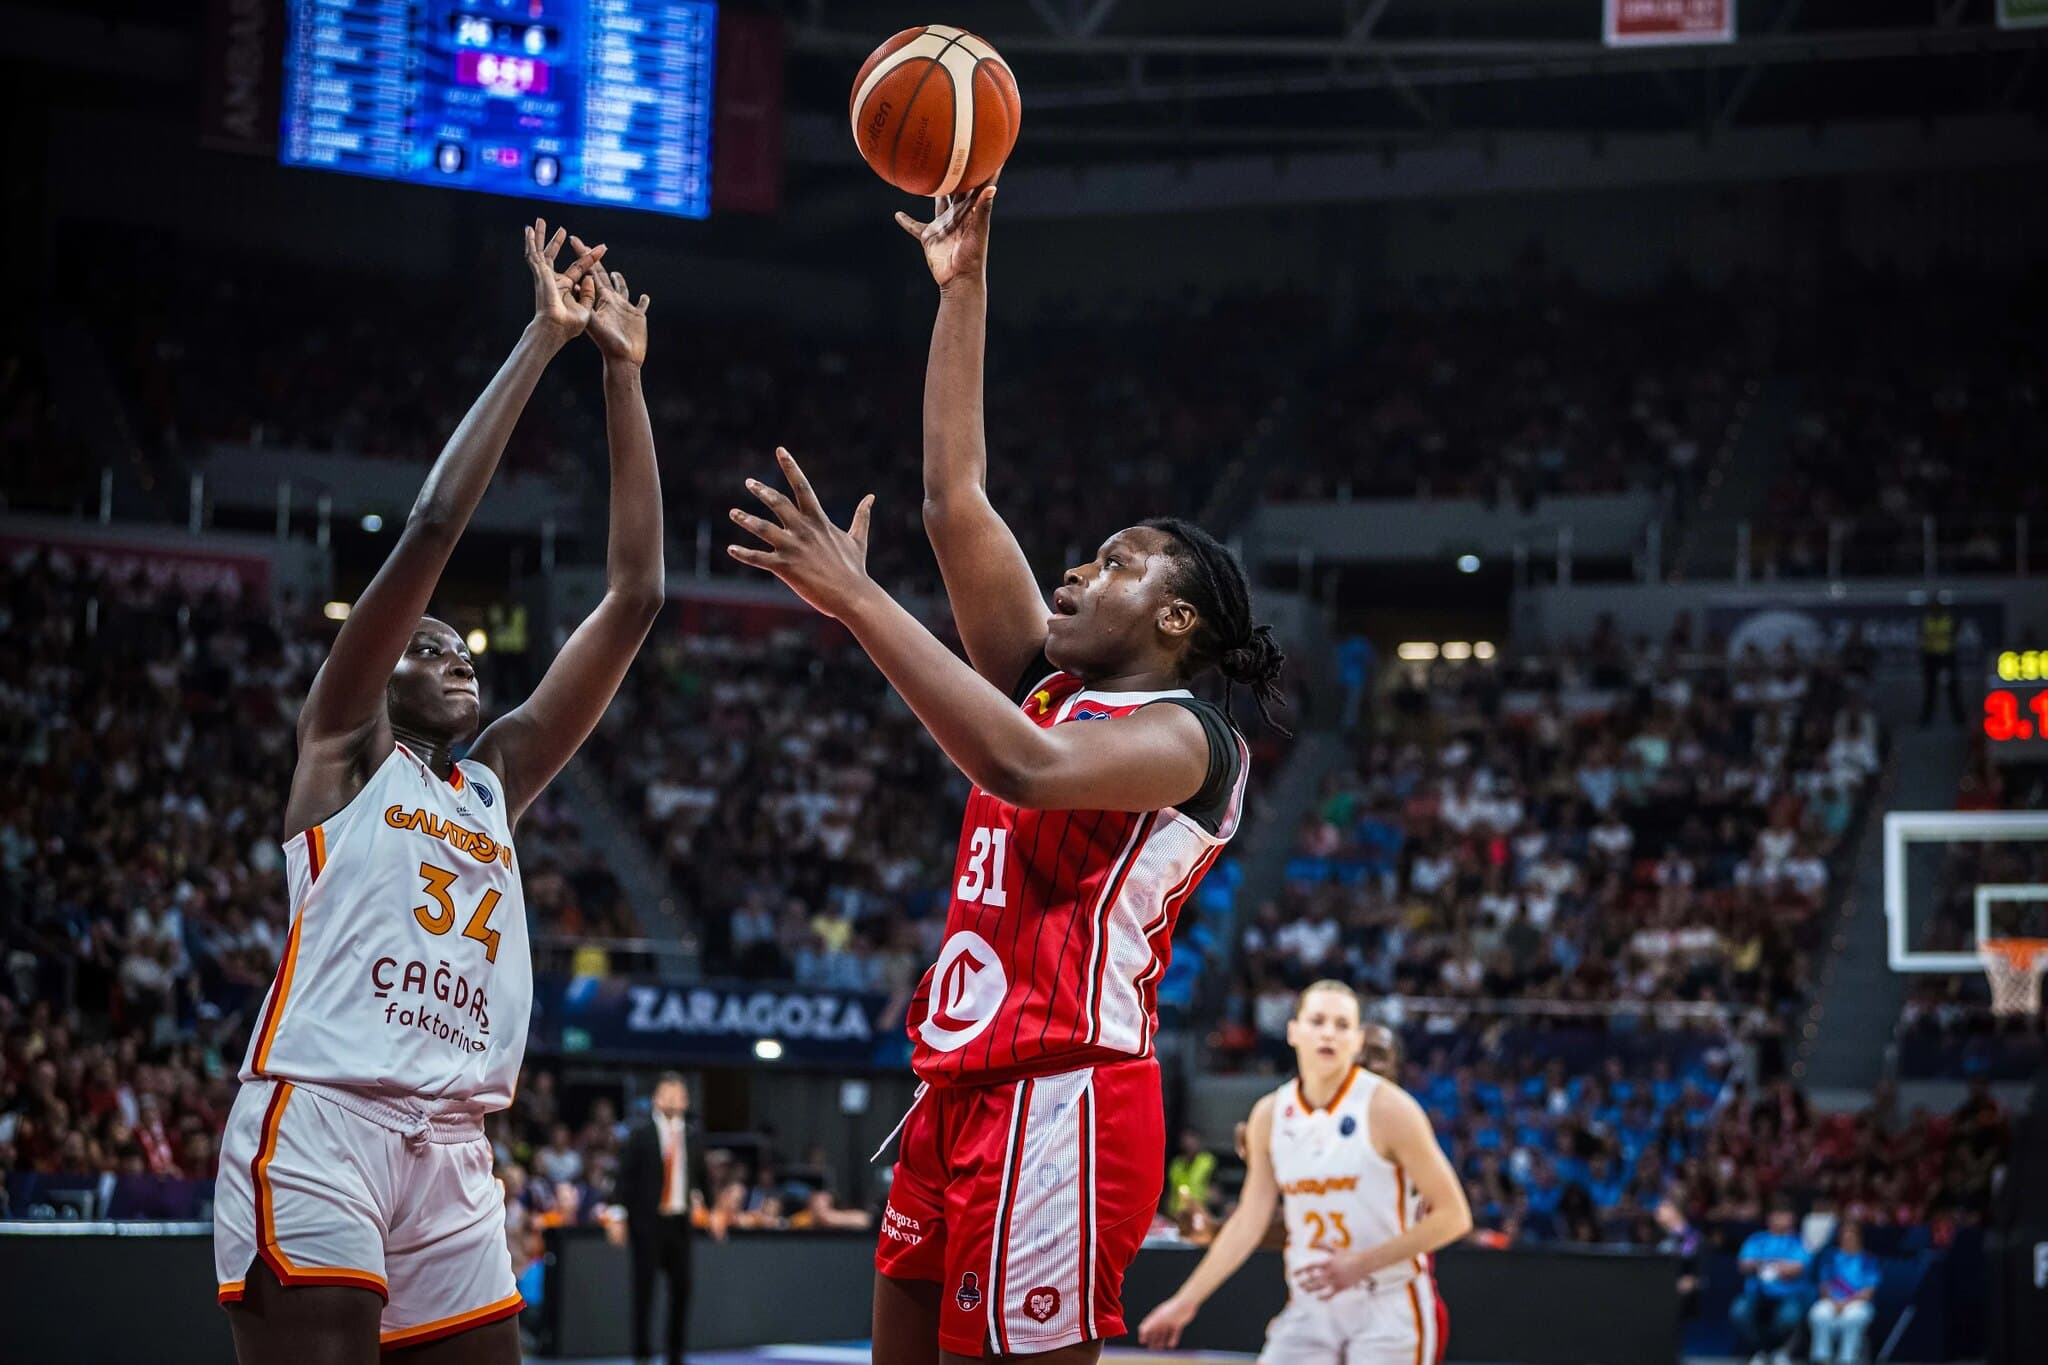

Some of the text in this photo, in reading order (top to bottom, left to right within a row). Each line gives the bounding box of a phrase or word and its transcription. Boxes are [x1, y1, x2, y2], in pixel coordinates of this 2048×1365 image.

[957, 827, 1008, 907] 31
[413, 861, 503, 964] 34
[628, 985, 871, 1042] ZARAGOZA
[1304, 1210, 1352, 1249] 23
